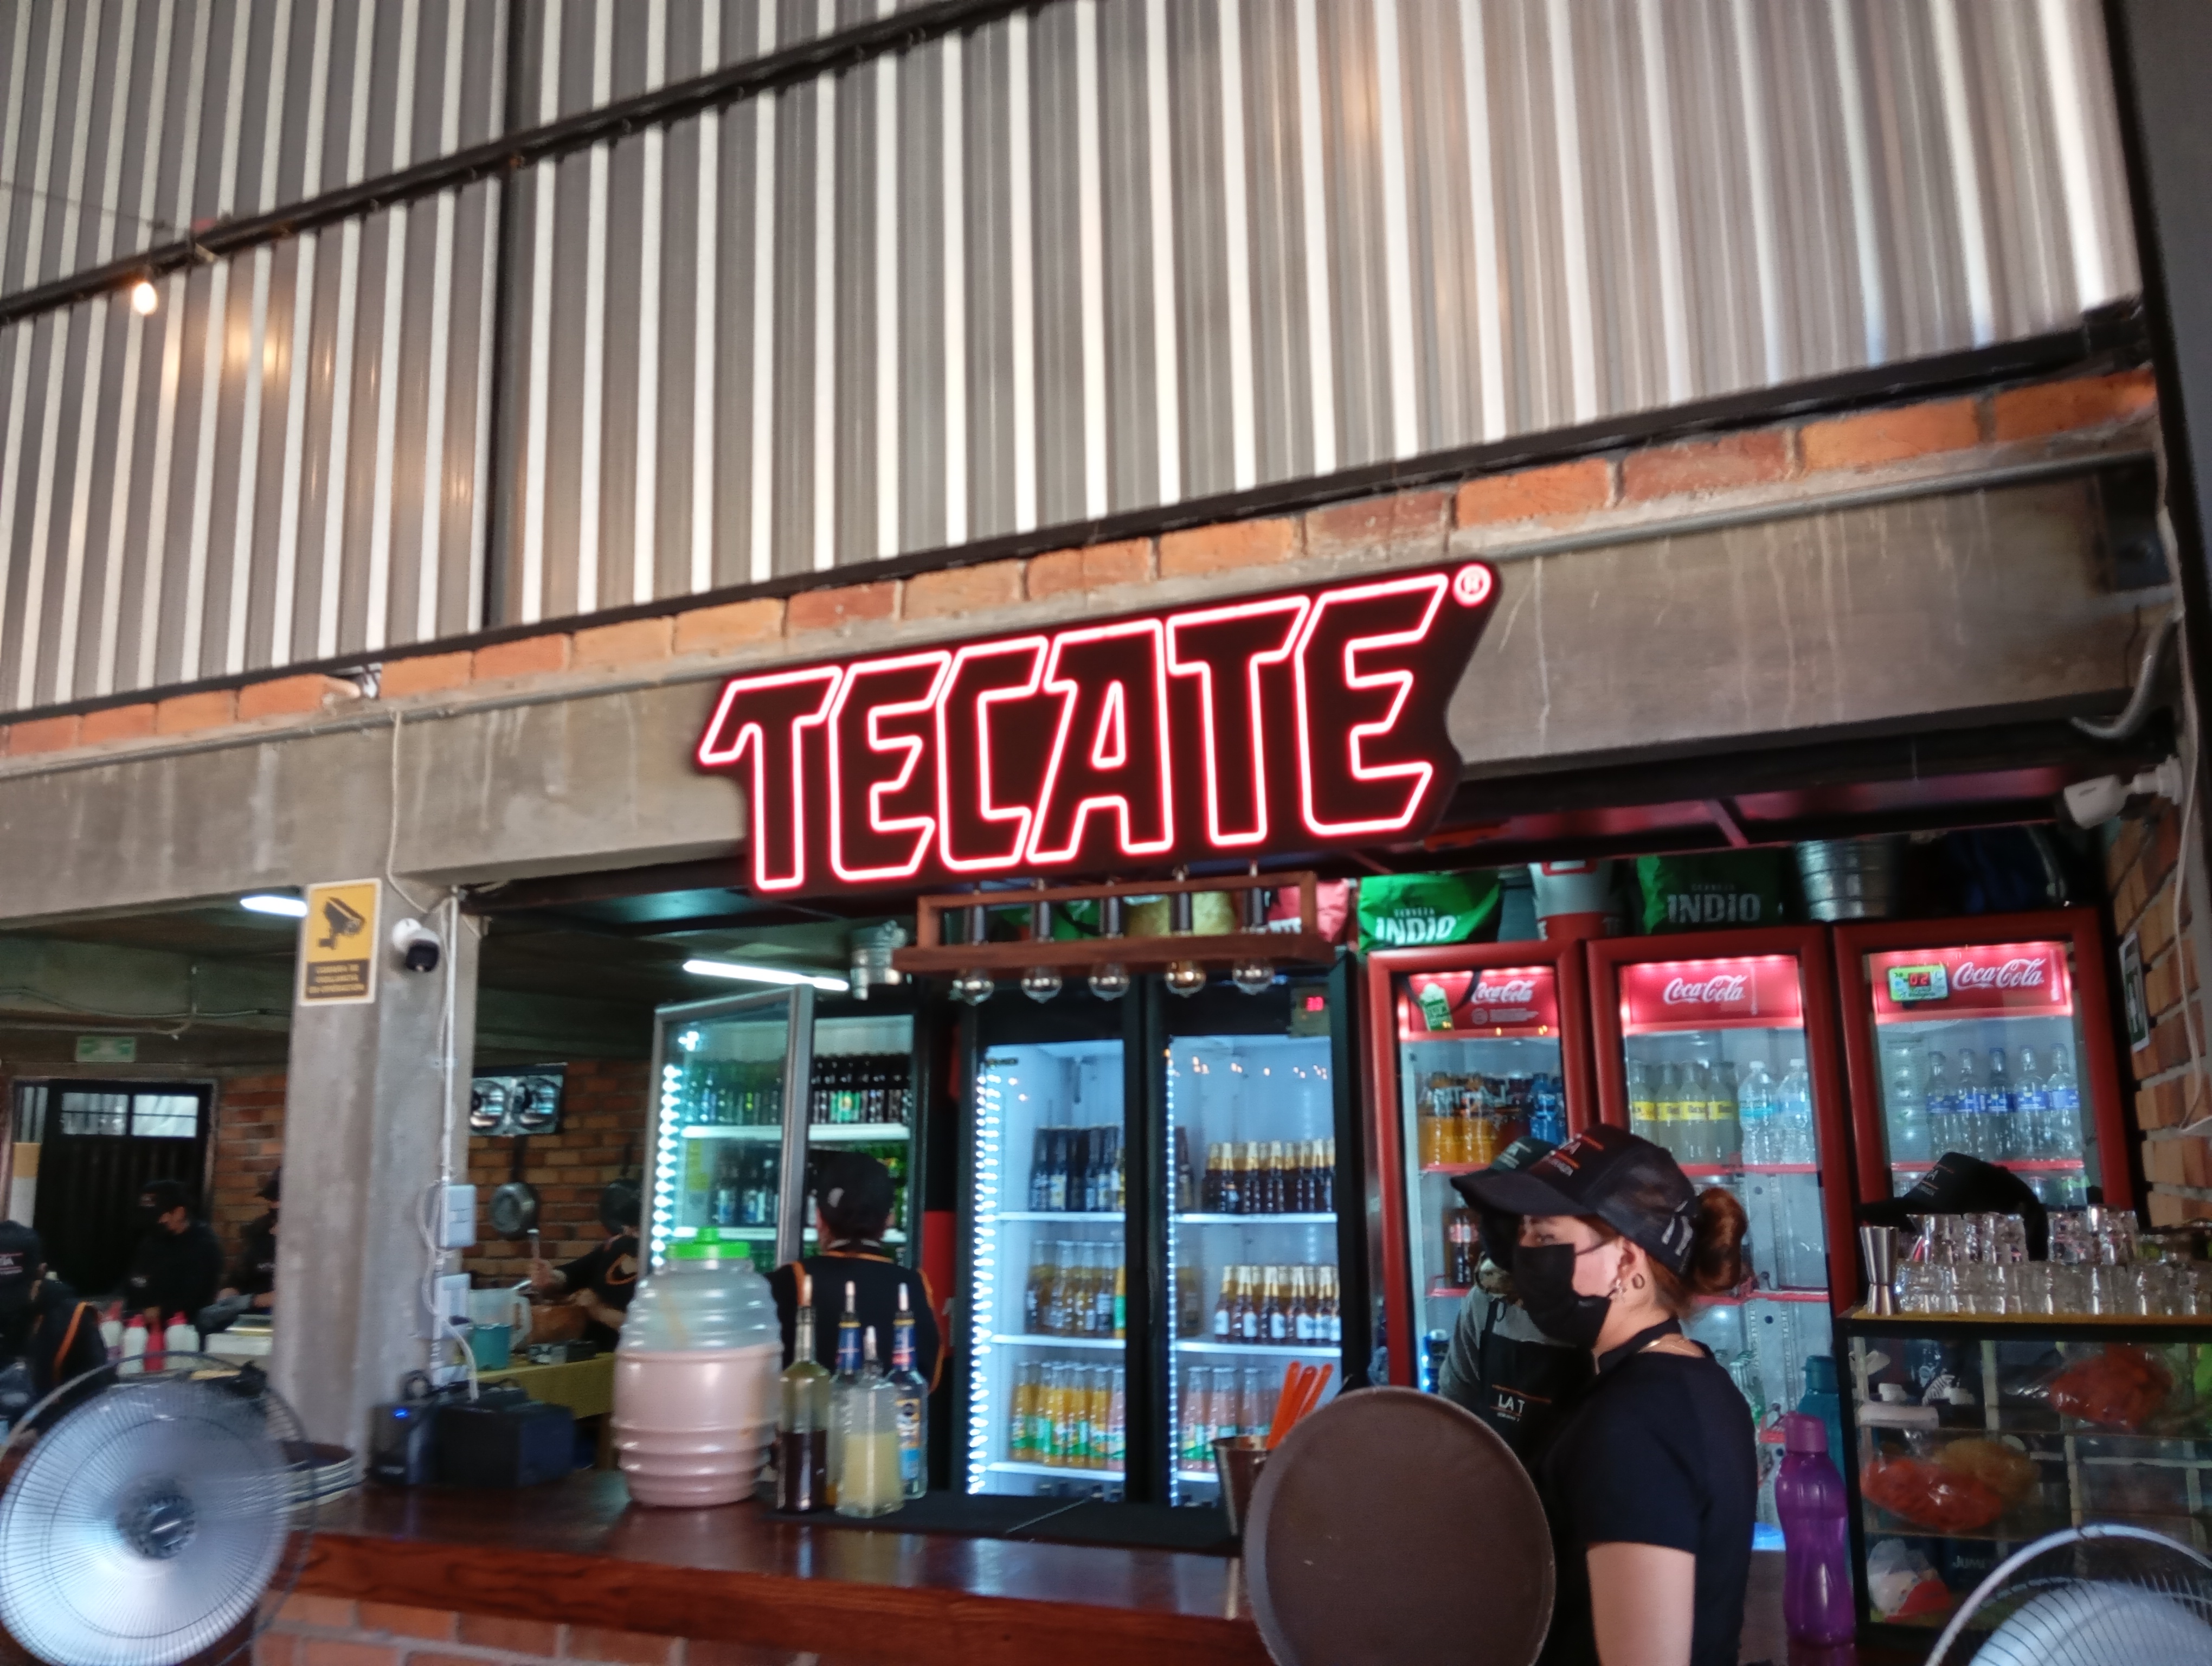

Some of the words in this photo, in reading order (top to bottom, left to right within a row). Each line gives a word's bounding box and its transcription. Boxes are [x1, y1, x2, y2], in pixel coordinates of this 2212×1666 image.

[698, 573, 1449, 890] TECATE
[1667, 893, 1761, 923] INDIO
[1375, 914, 1457, 945] INDIO
[1952, 958, 2047, 991] Coca-Cola
[1470, 979, 1536, 1004] Coca-Cola
[1663, 975, 1748, 1005] Coca-Cola
